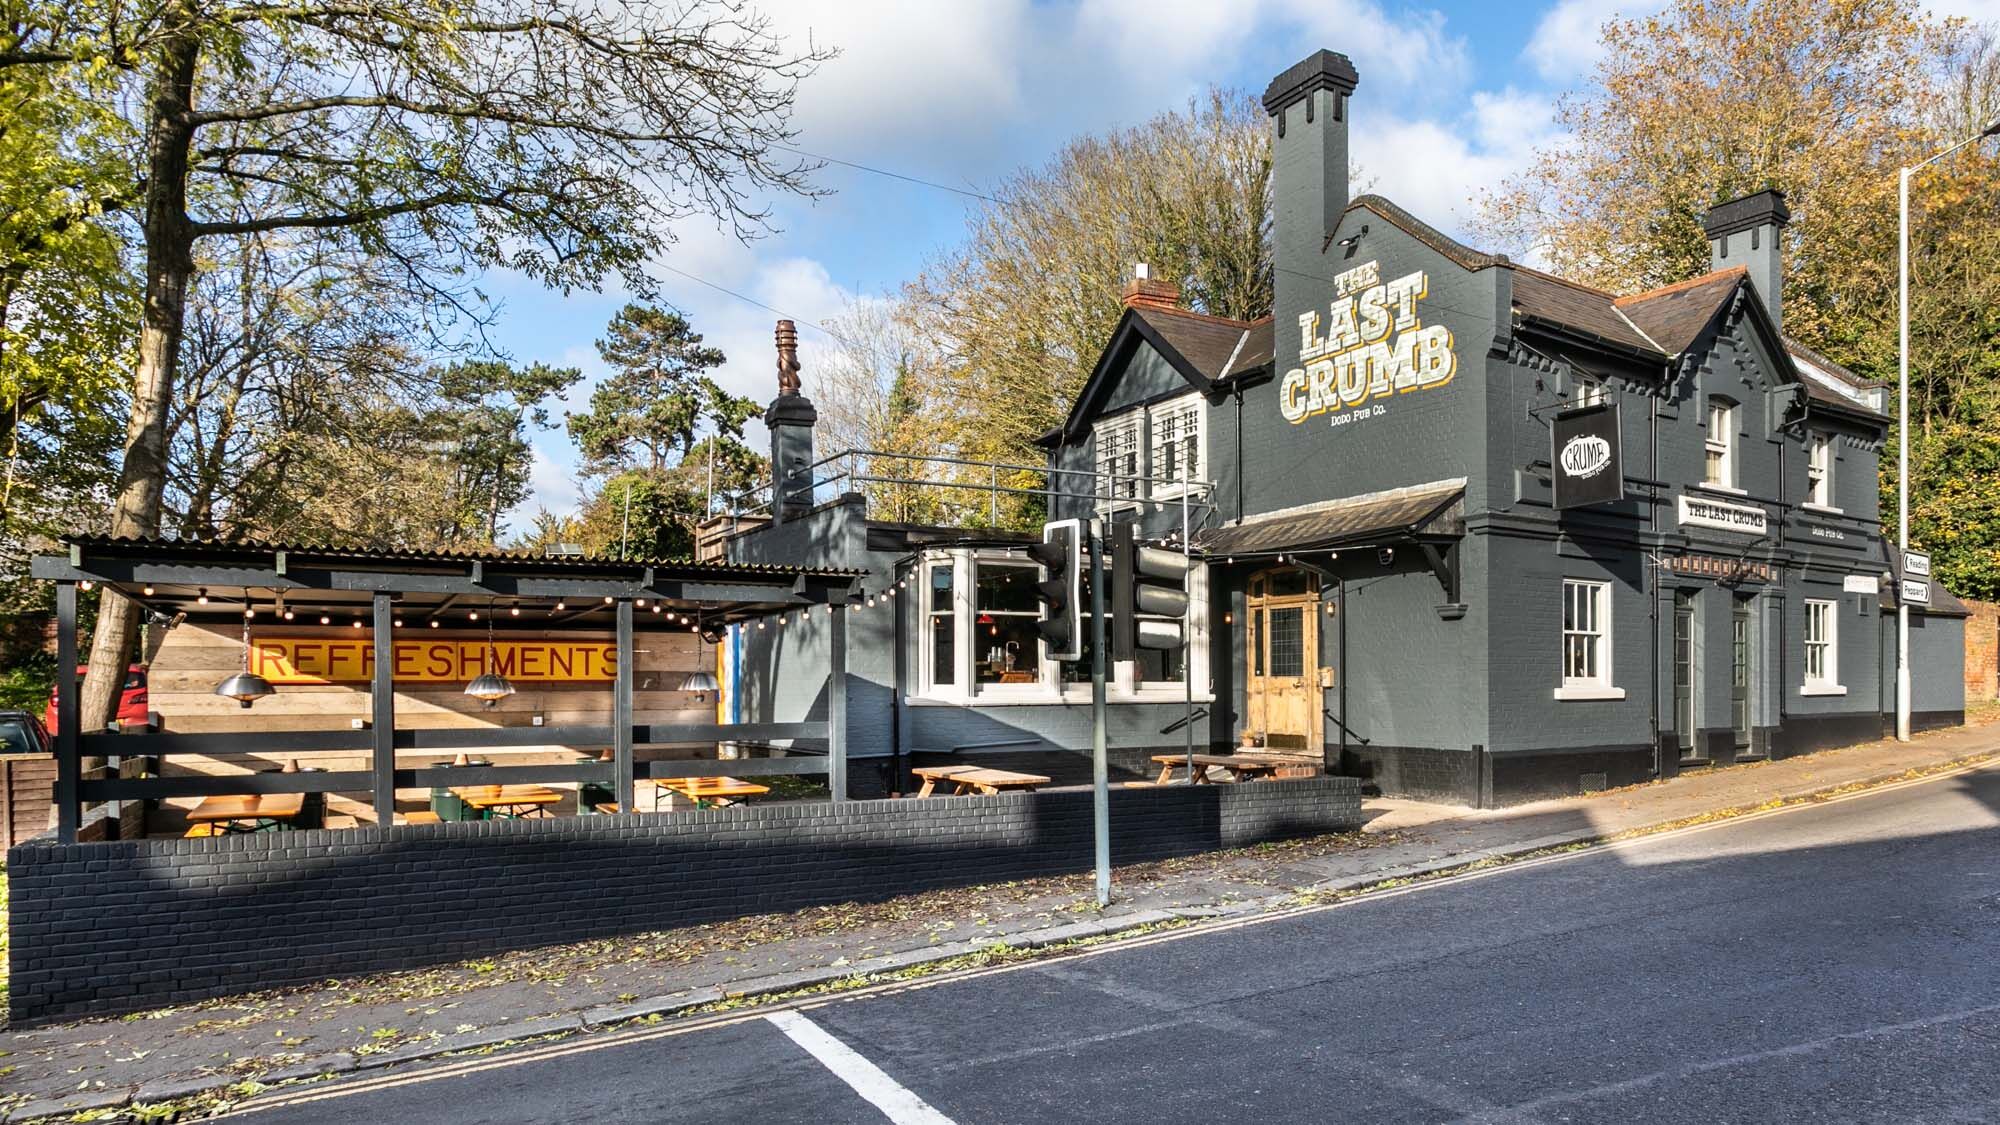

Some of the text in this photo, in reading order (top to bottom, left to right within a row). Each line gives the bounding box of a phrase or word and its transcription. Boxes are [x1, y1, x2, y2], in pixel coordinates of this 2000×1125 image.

[1334, 260, 1379, 297] THE
[1299, 270, 1428, 366] LAST
[1280, 325, 1457, 424] CRUMB
[1566, 443, 1604, 470] CRUMB
[1688, 503, 1764, 528] THE LAST CRUMB
[1910, 558, 1928, 571] Reading
